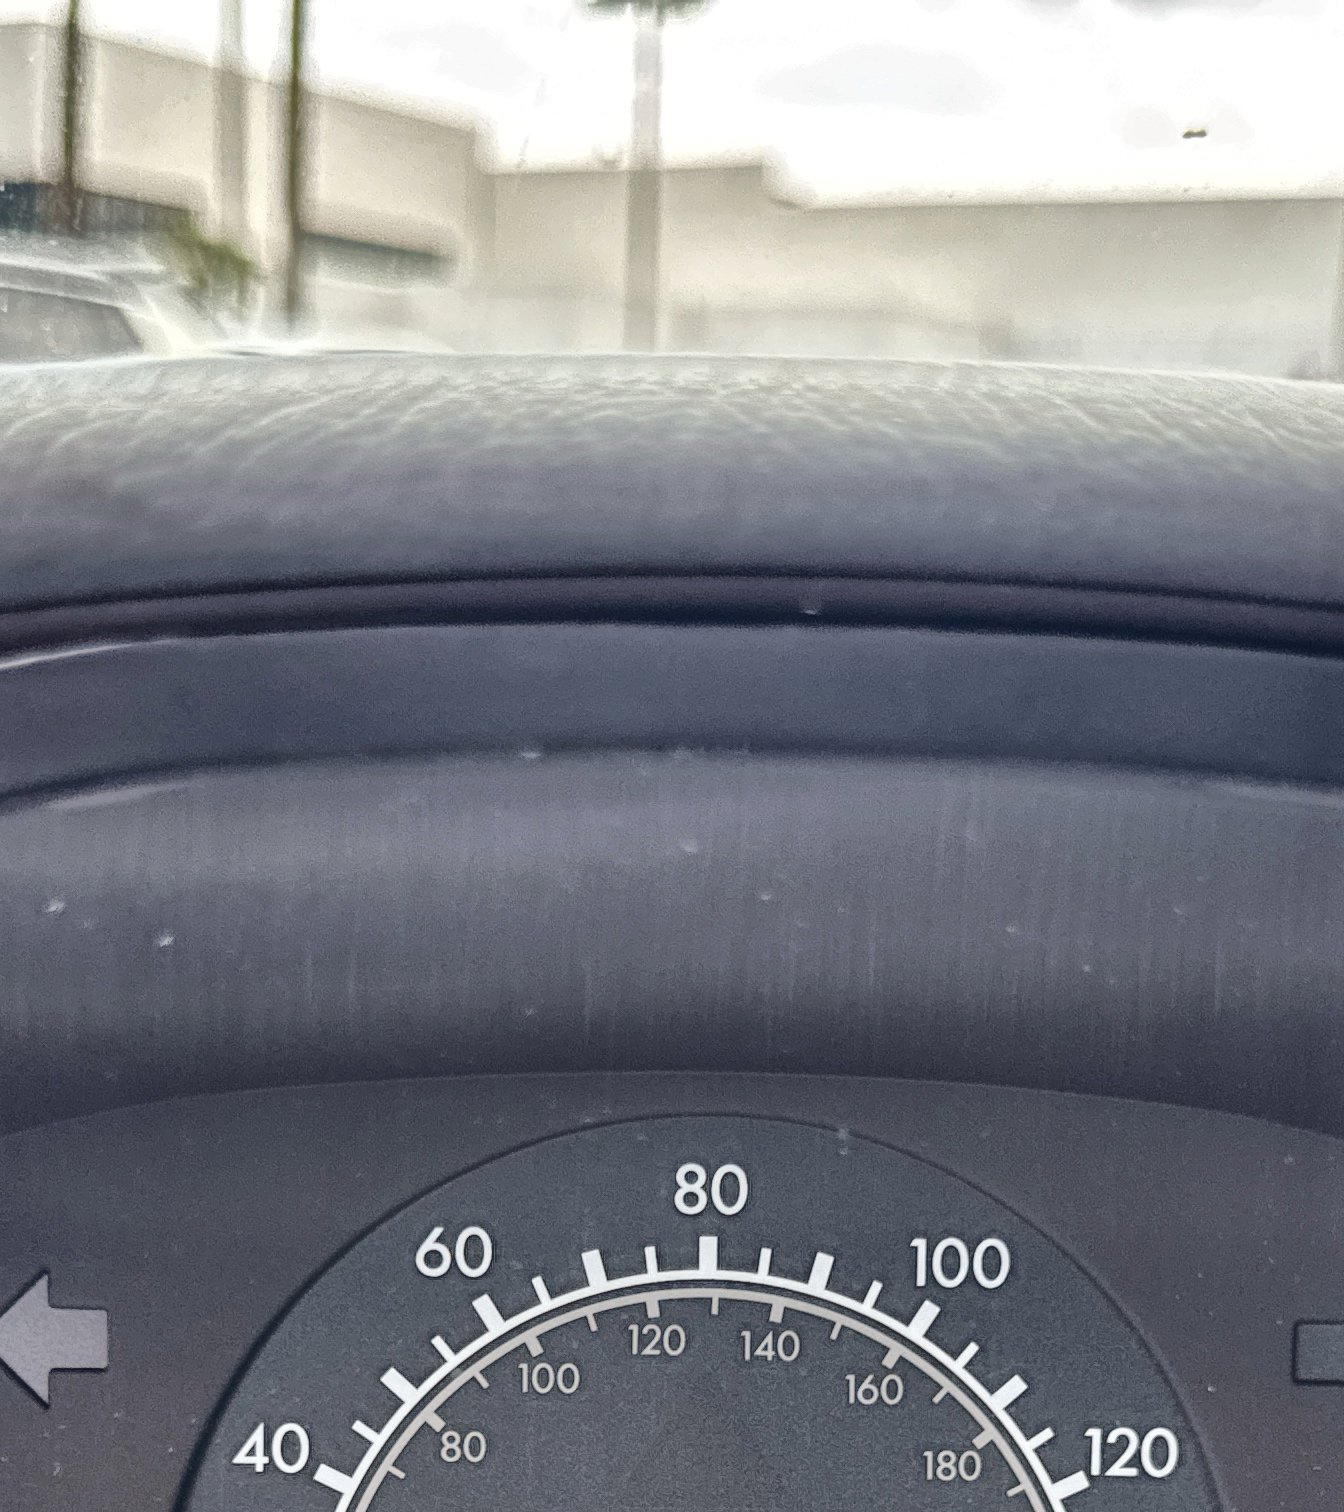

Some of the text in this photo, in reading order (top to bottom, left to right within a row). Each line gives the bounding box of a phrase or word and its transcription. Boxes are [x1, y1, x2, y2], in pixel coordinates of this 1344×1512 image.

[674, 1162, 749, 1216] 80
[415, 1225, 493, 1278] 60
[909, 1236, 1011, 1289] 100
[628, 1323, 686, 1357] 120
[740, 1329, 800, 1362] 140
[518, 1362, 580, 1394] 100
[845, 1373, 904, 1406] 160
[231, 1422, 310, 1474] 40
[440, 1430, 487, 1463] 80
[1084, 1427, 1179, 1478] 120
[922, 1449, 982, 1482] 180
